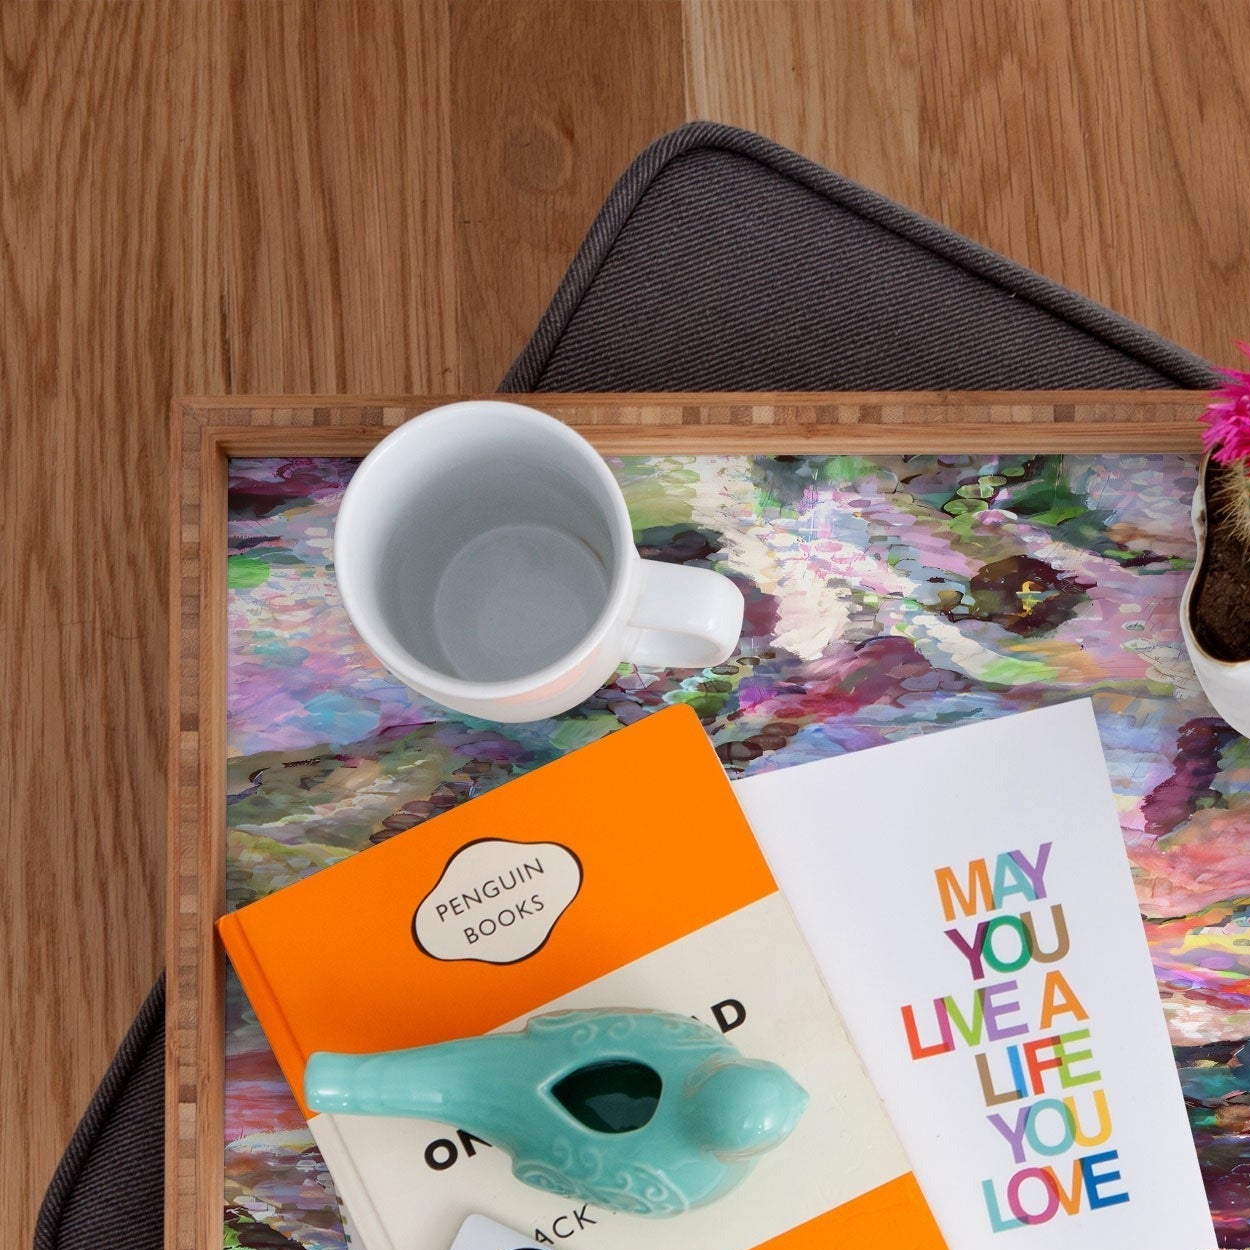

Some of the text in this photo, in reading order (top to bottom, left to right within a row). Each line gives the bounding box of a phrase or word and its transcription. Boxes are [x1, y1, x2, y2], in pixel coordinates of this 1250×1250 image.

[435, 857, 545, 922] PENGUIN
[463, 894, 545, 945] BOOKS
[934, 841, 1053, 922] MAY
[943, 903, 1070, 981] YOU
[900, 969, 1090, 1061] LIVE A
[974, 1028, 1102, 1107] LIFE
[986, 1088, 1113, 1164] YOU
[534, 1202, 598, 1245] ACK
[981, 1149, 1130, 1234] LOVE
